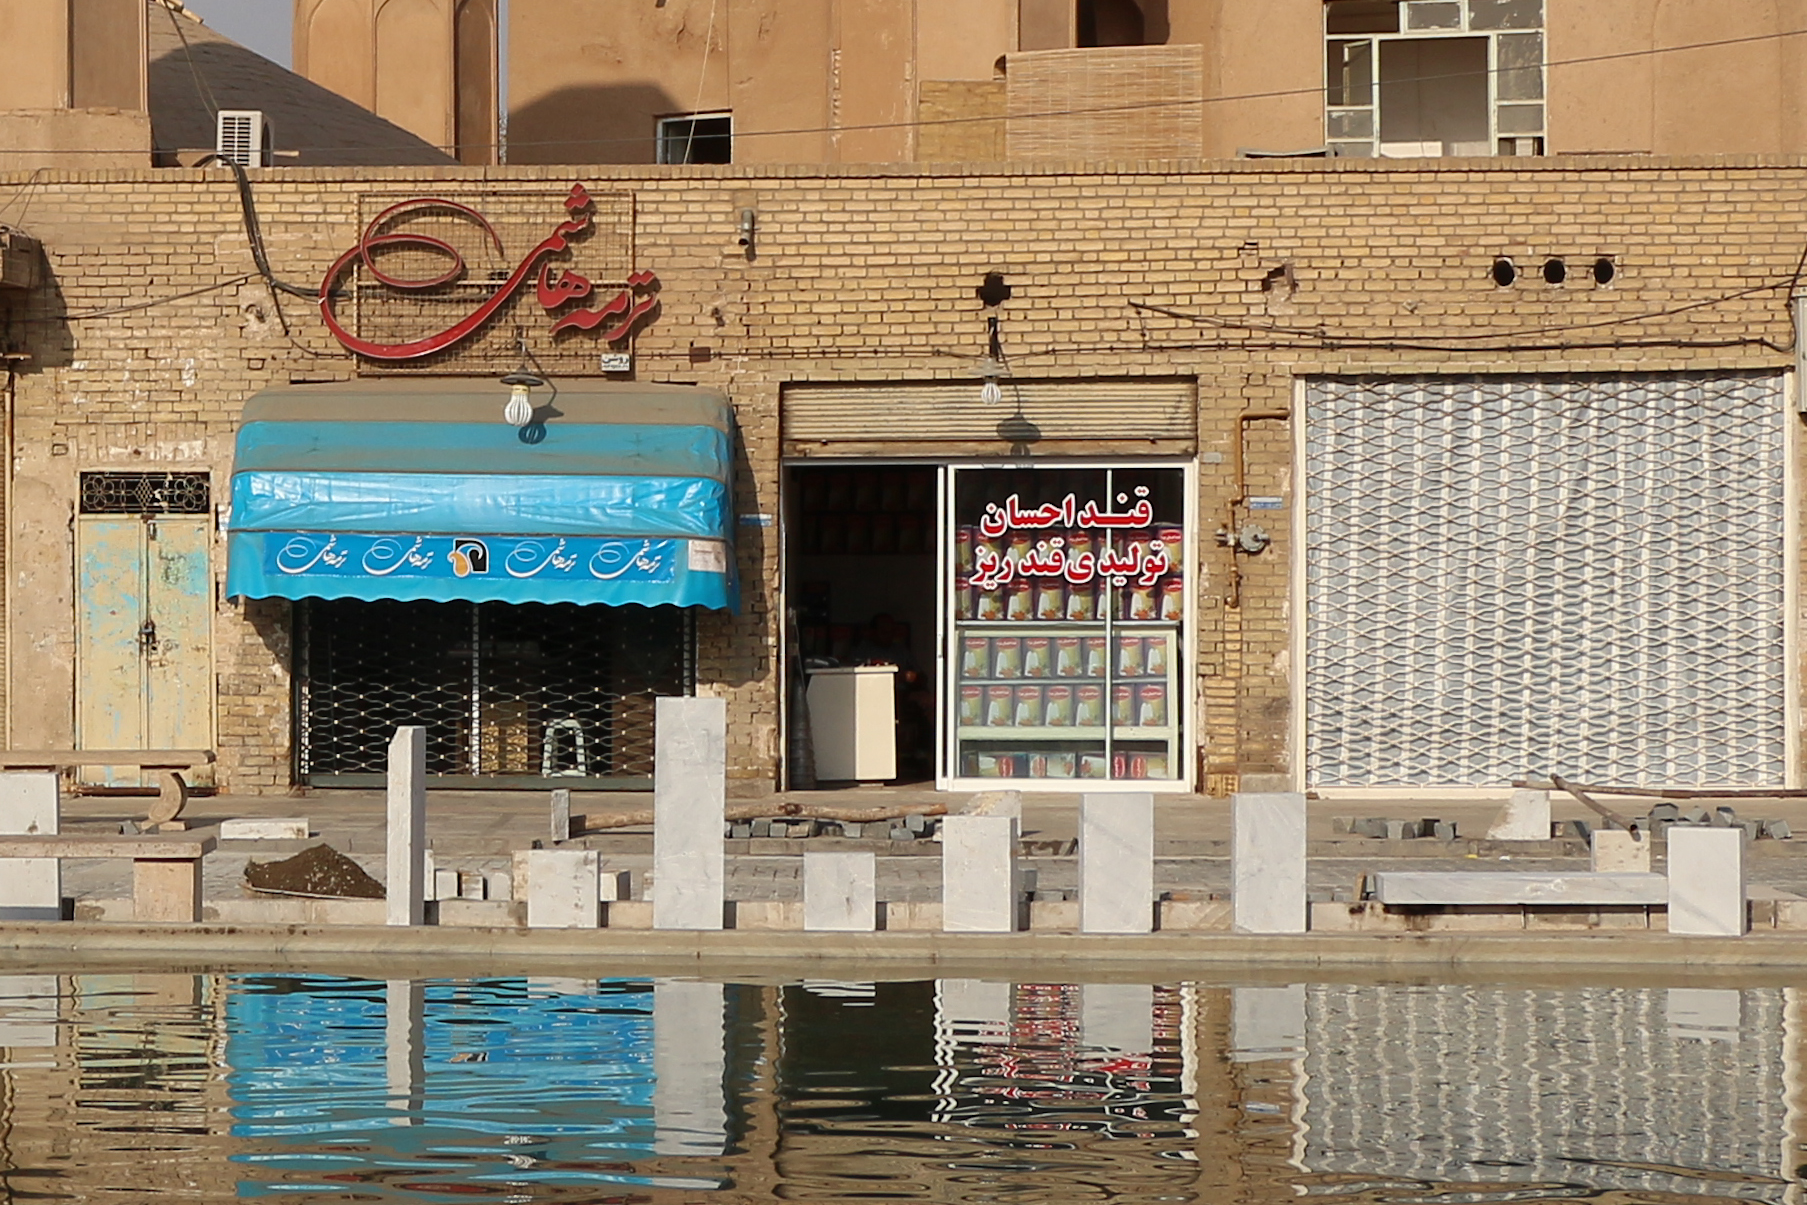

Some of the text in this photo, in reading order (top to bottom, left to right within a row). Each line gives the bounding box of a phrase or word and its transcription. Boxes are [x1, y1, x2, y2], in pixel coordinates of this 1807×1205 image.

[980, 486, 1153, 537] قند احسان
[969, 546, 1014, 590] ریز
[1018, 538, 1066, 575] قند
